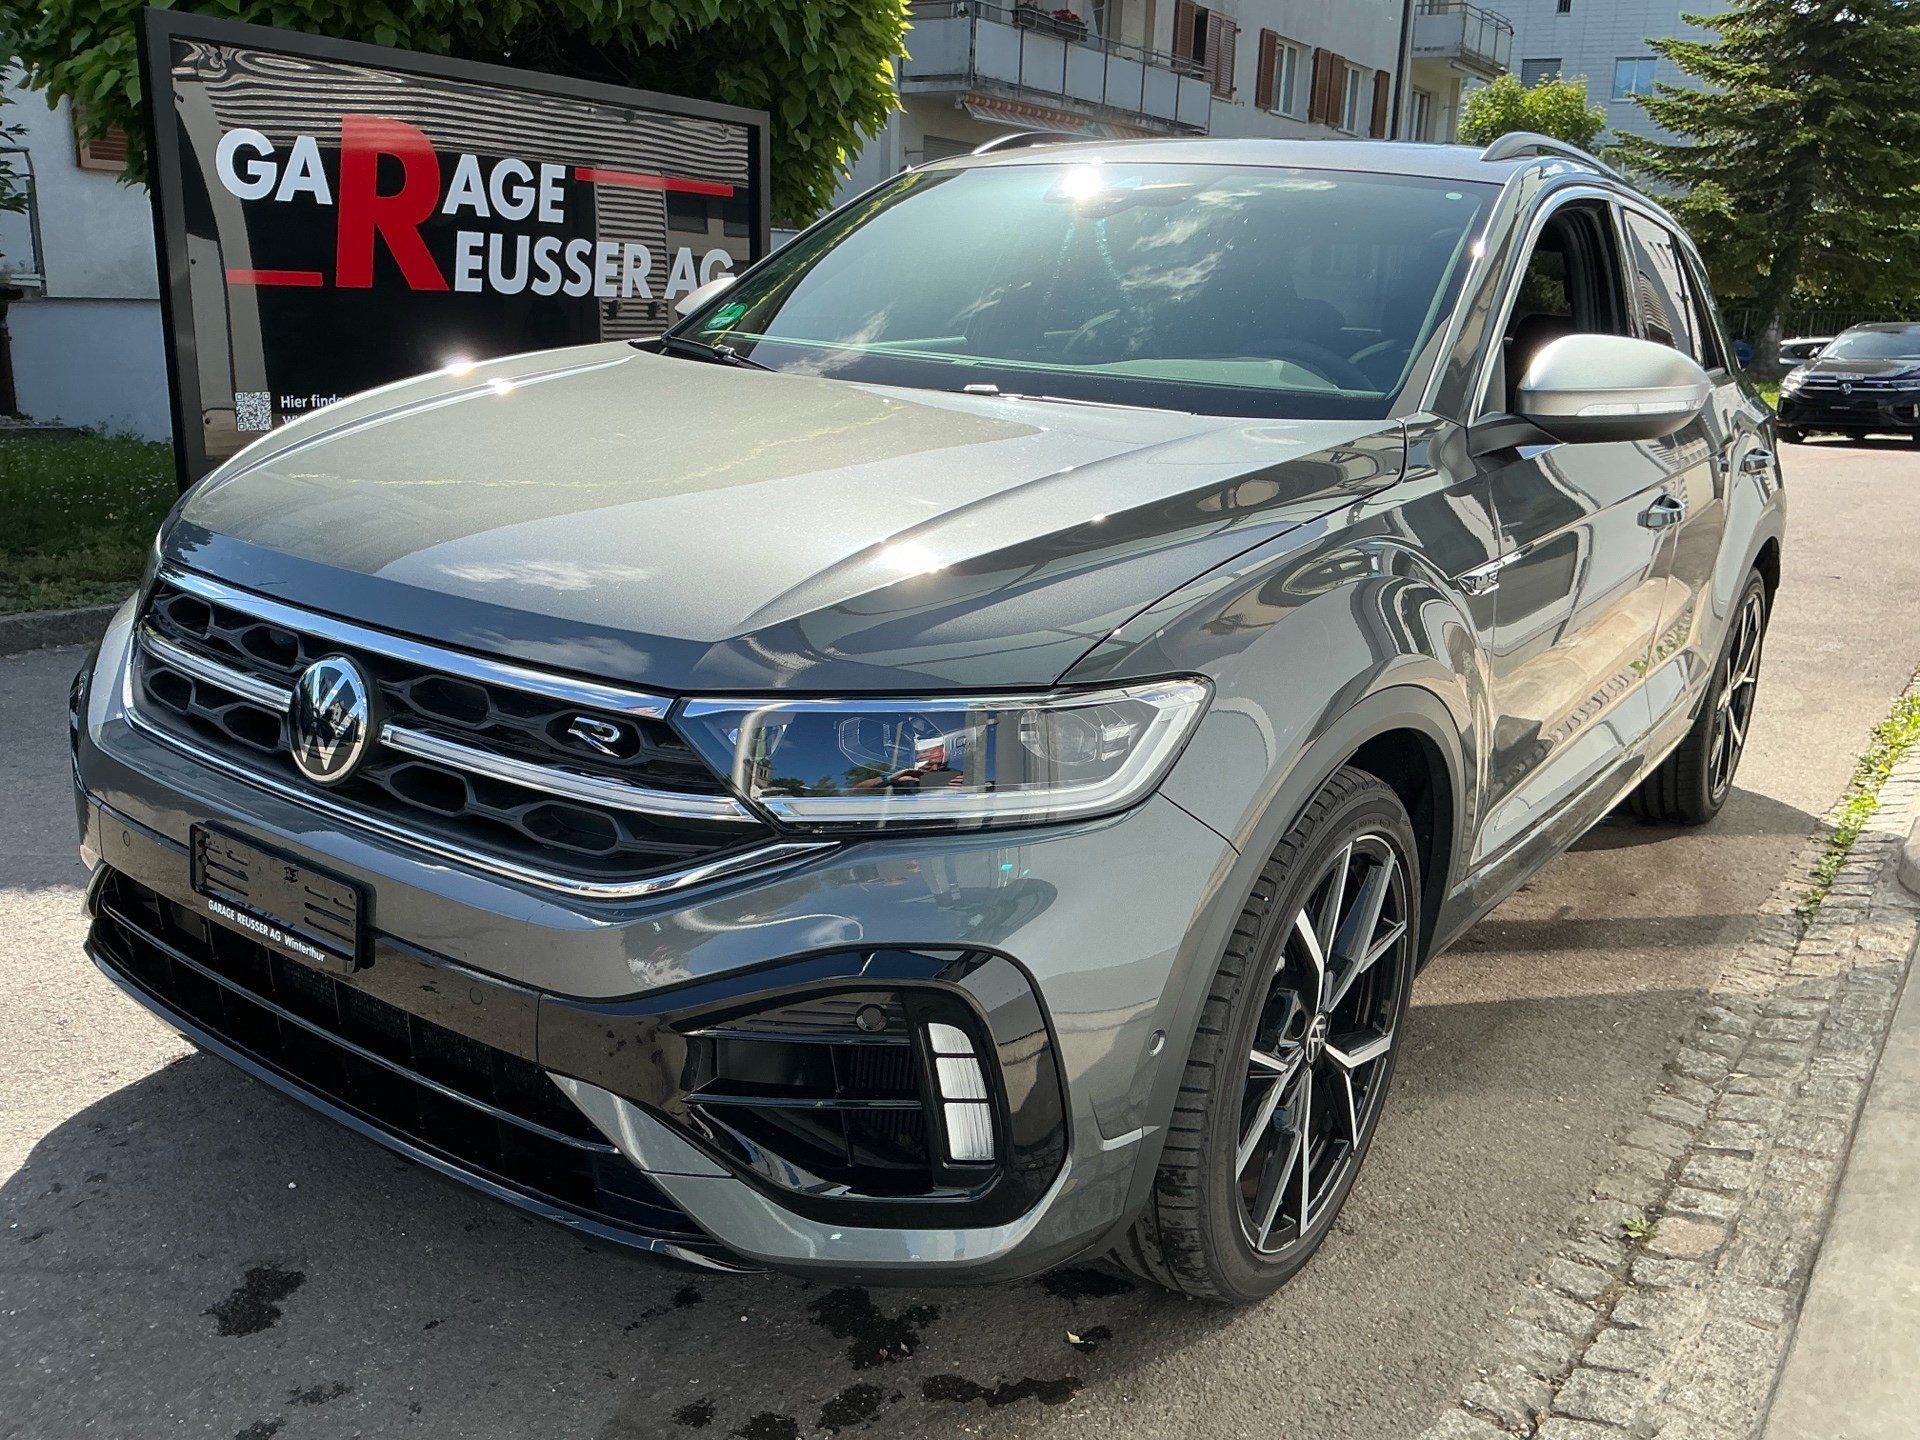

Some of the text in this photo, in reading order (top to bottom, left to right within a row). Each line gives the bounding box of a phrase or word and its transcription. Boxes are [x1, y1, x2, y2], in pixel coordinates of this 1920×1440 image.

[215, 115, 566, 291] GARAGE
[664, 246, 734, 300] AG
[280, 395, 307, 409] Hier
[208, 900, 326, 962] GARAGE REUSSER AG Winterthur
